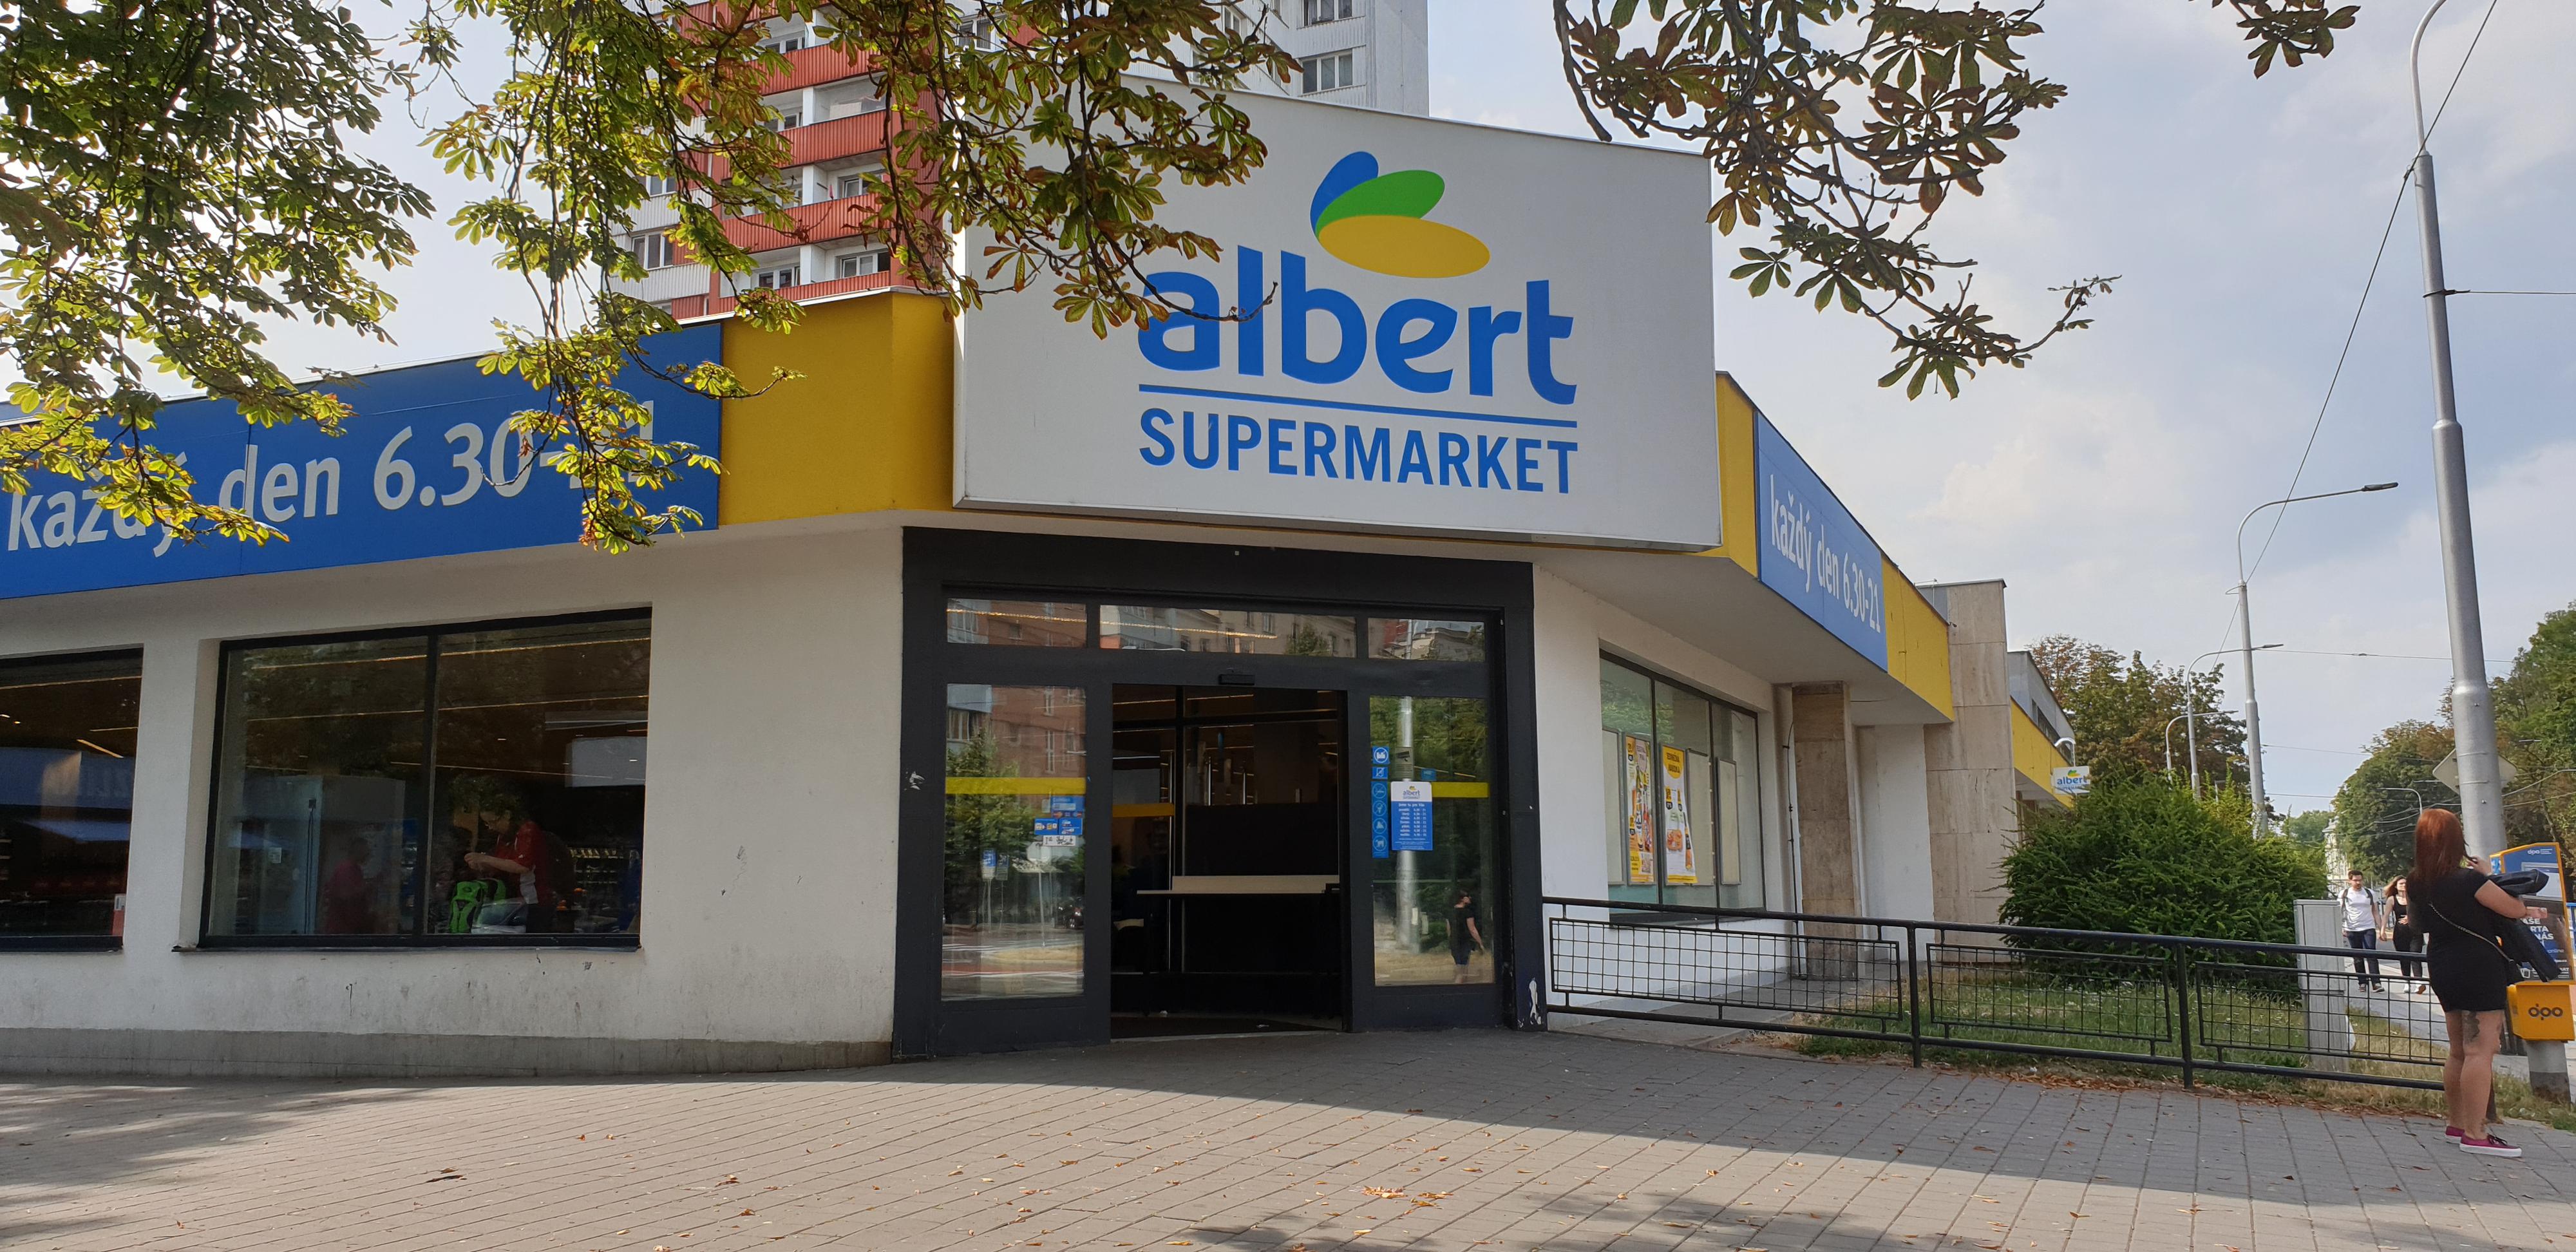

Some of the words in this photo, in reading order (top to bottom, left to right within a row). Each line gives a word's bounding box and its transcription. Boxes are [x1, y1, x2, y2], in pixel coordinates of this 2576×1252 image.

[1137, 245, 1577, 404] albert
[218, 444, 341, 522] den
[1139, 408, 1578, 494] SUPERMARKET
[1770, 474, 1812, 593] každý
[1817, 524, 1839, 600] den
[1843, 552, 1880, 633] 6.30-21
